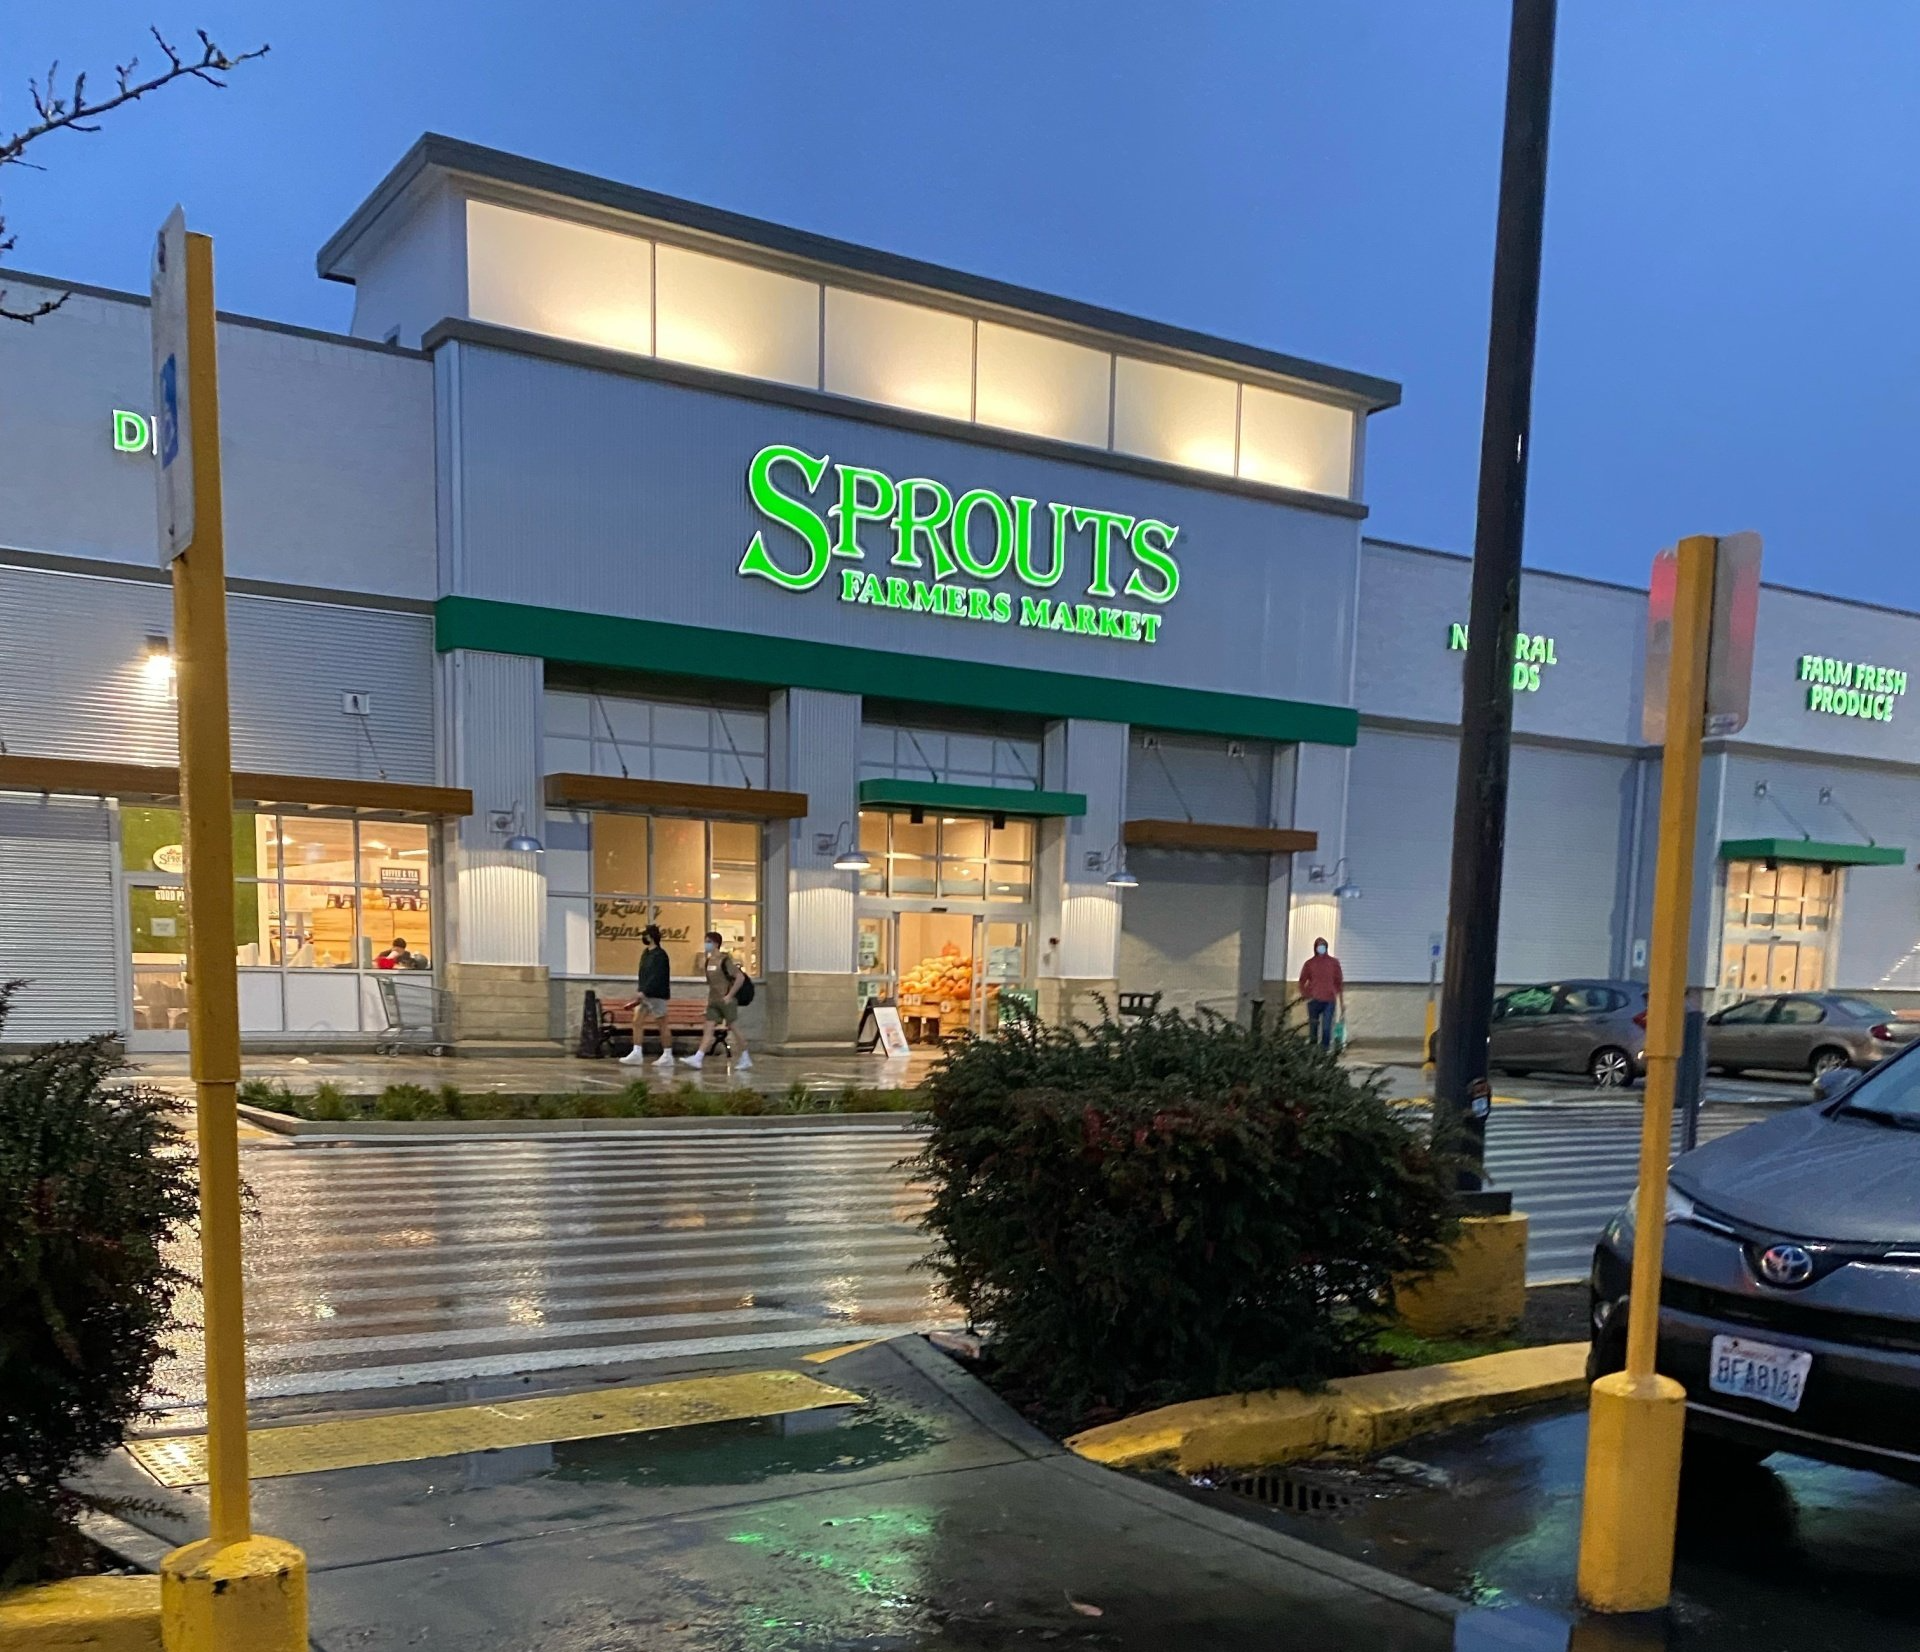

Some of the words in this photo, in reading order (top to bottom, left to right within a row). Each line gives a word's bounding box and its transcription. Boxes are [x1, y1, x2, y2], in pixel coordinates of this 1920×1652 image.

[841, 569, 1012, 623] FARMERS
[1019, 596, 1162, 643] MARKET
[1451, 622, 1558, 665] NRAL
[1801, 654, 1853, 687] FARM
[1855, 663, 1907, 696] FRESH
[1811, 683, 1895, 722] PRODUCE
[408, 870, 418, 878] TEA
[660, 925, 690, 940] ere!
